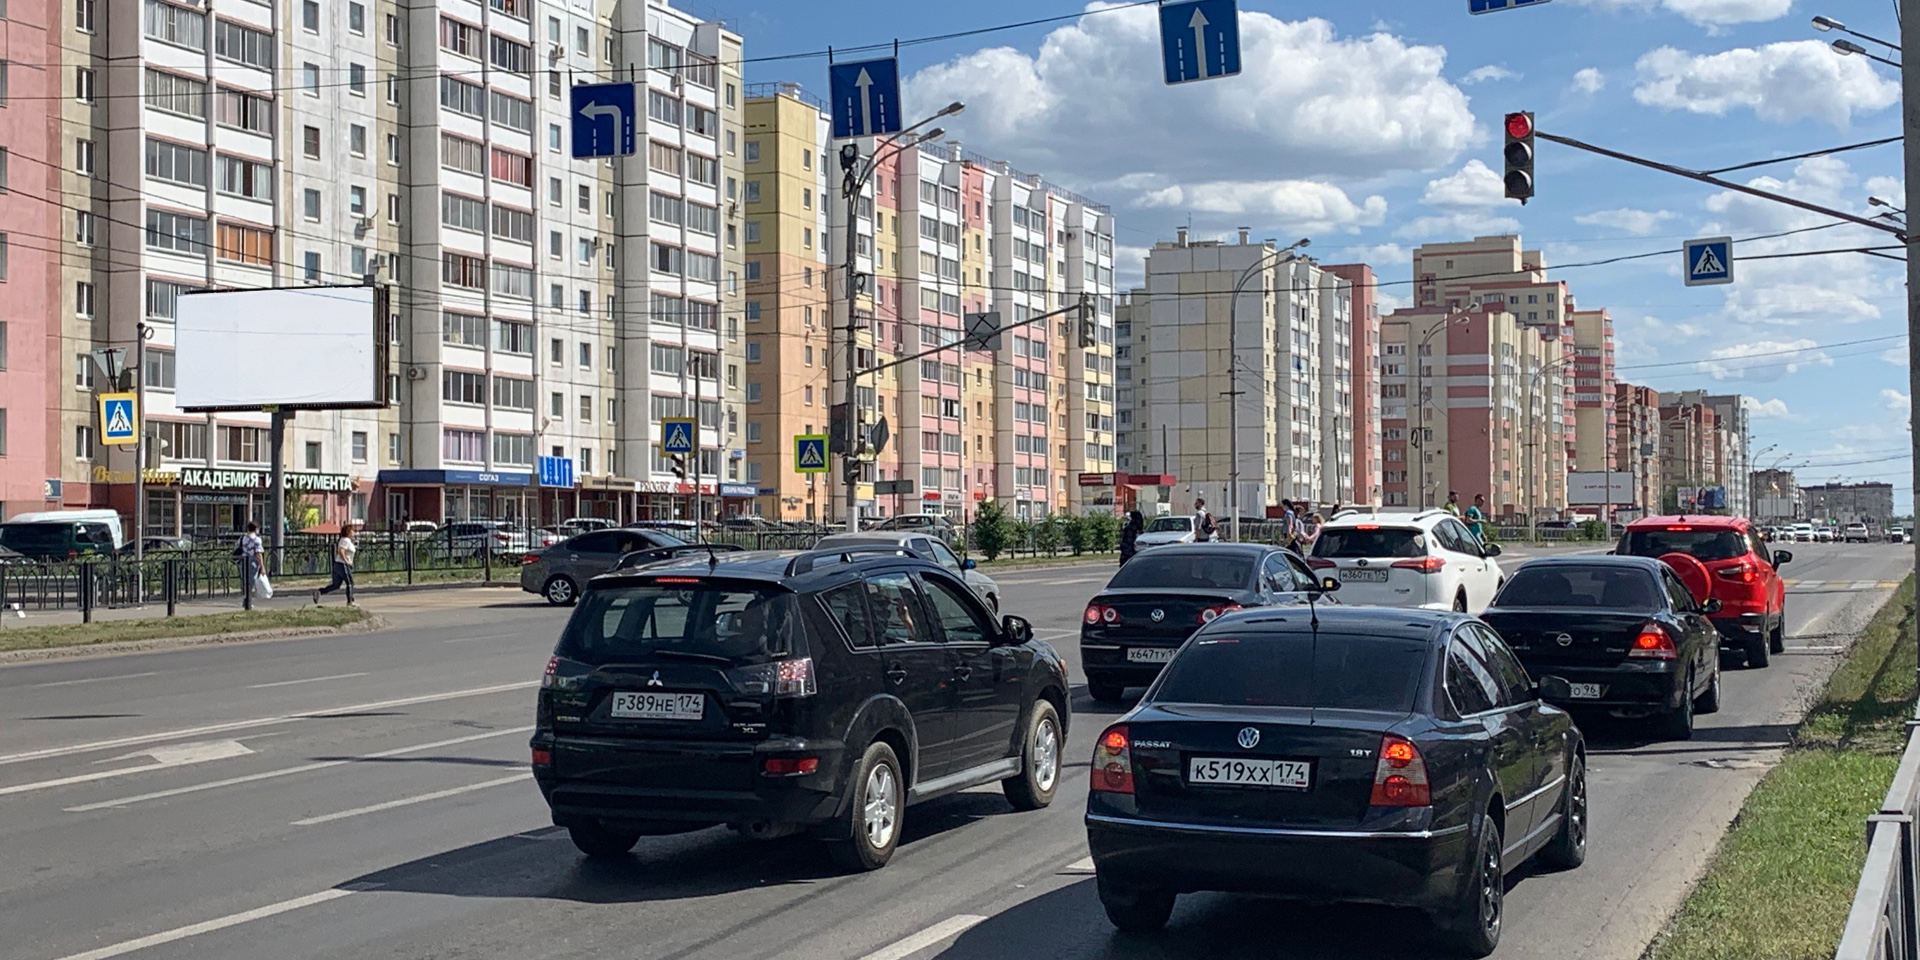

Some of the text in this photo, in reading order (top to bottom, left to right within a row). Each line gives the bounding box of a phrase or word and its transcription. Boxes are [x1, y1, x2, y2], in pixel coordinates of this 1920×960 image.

[183, 470, 352, 491] АКАДЕМИЯ ИСТРУМЕНТА
[478, 473, 499, 482] СОГАЗ
[1583, 684, 1596, 694] 96
[617, 694, 702, 713] Р389НЕ 174
[1134, 740, 1172, 748] PASSAT
[1195, 760, 1305, 783] К519ХХ 174
